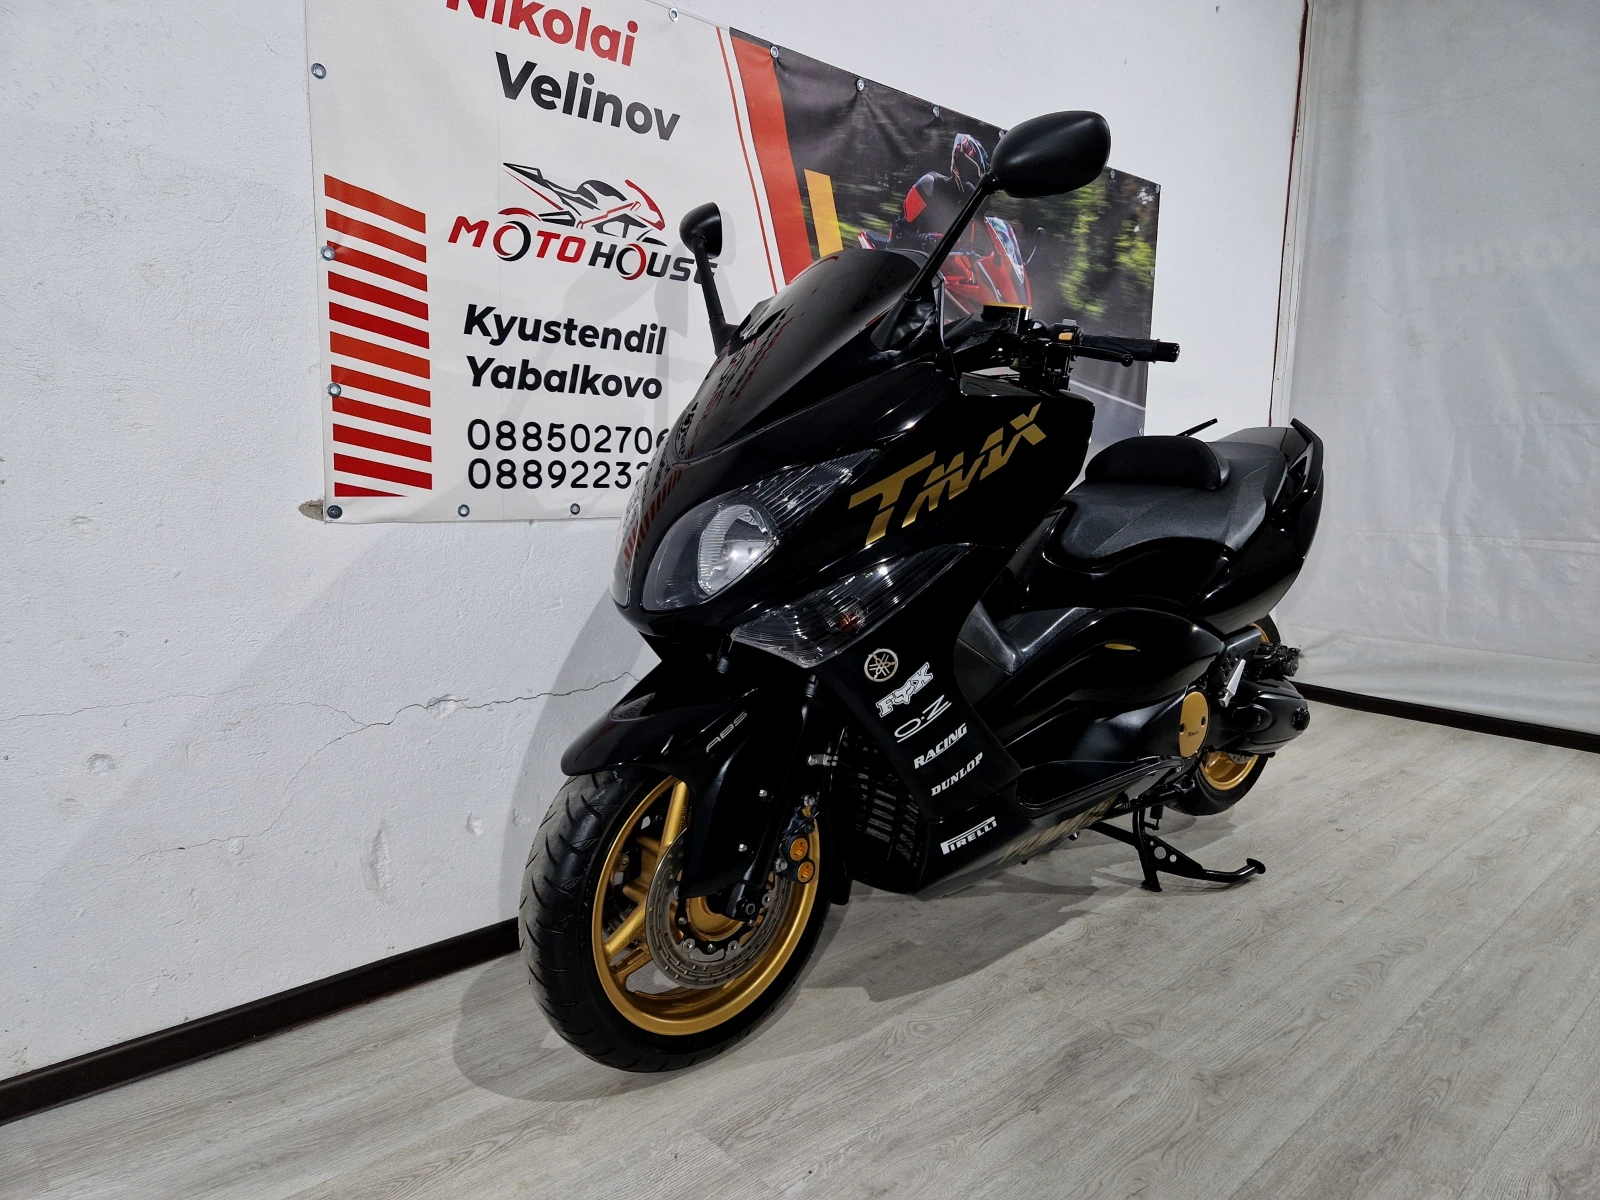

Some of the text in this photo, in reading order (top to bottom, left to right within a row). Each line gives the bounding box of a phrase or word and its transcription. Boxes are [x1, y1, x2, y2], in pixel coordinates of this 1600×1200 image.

[495, 52, 681, 141] Velinov
[463, 303, 668, 355] Kyustendil
[466, 355, 663, 400] Yabalkovo
[705, 710, 748, 753] ABS
[913, 722, 968, 770] RACING
[930, 751, 984, 797] DUNLOP
[939, 815, 998, 856] PIRELLI
